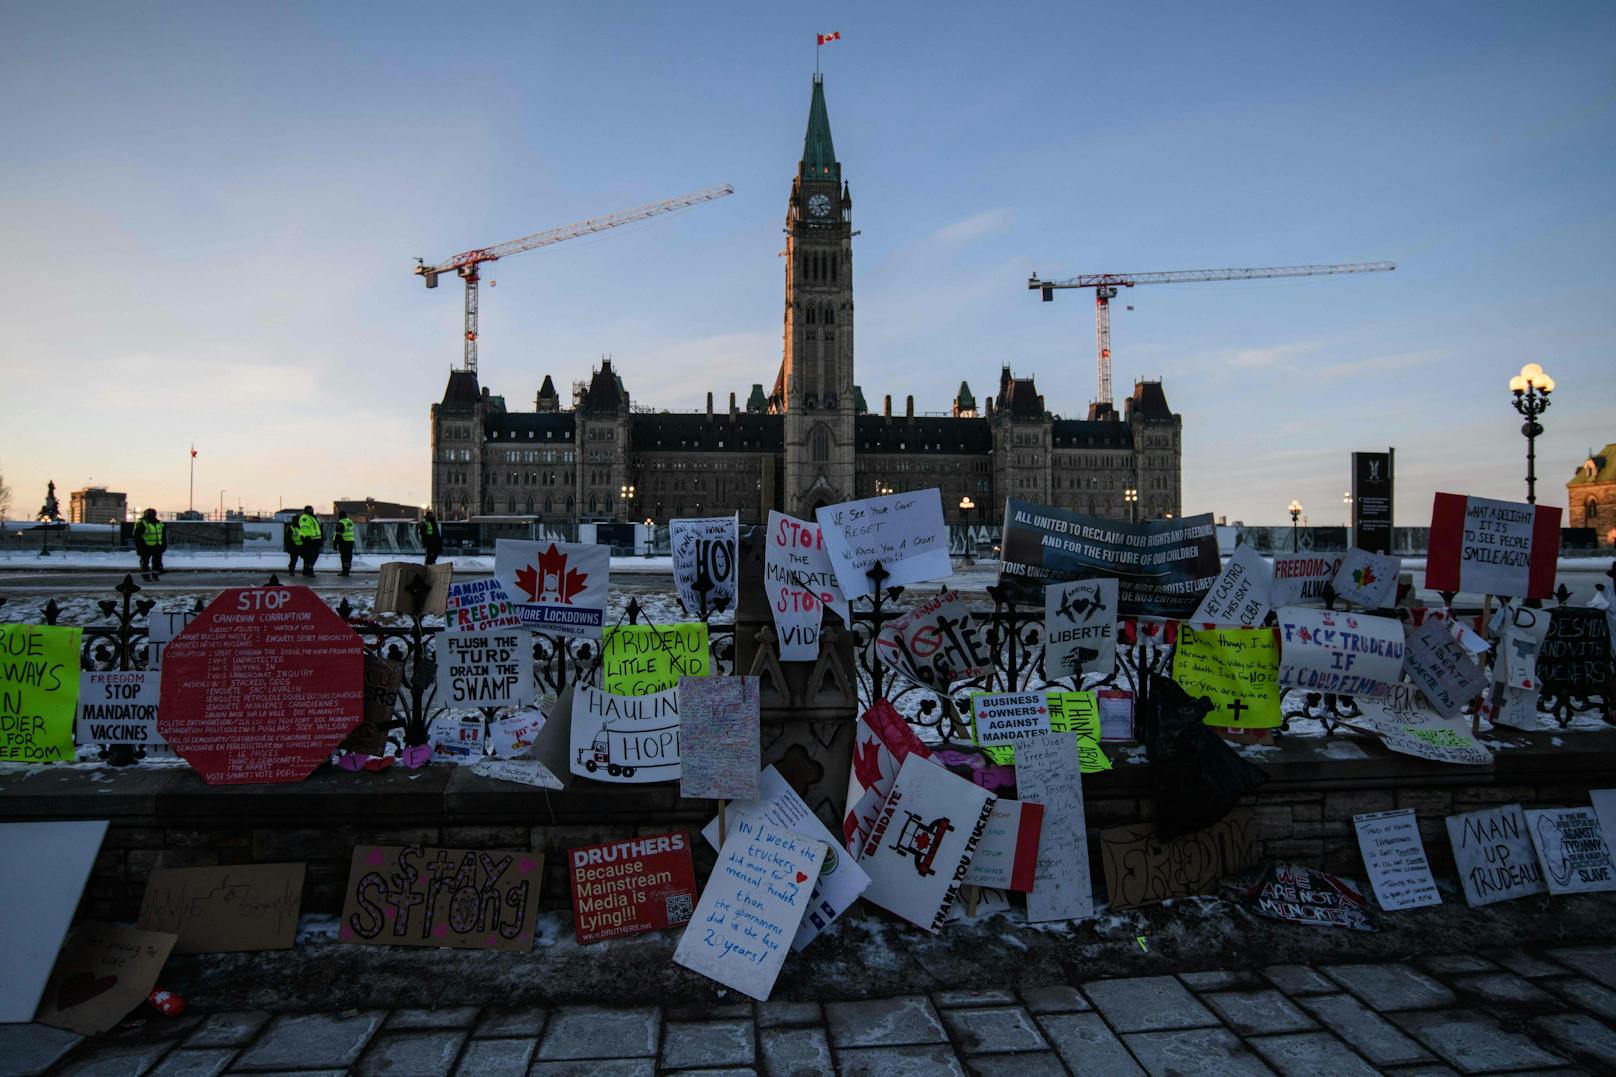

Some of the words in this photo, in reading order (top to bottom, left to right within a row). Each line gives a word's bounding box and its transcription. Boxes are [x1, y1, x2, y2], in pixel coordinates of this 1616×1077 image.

[831, 512, 843, 526] WE
[1466, 505, 1489, 519] WHAT
[1489, 508, 1497, 519] A
[1497, 508, 1533, 524] DELIGHT
[845, 522, 886, 538] RESET
[1015, 511, 1033, 525] ALL
[1033, 515, 1068, 533] UNITED
[1069, 522, 1081, 536] TO
[1082, 526, 1124, 546] RECLAIM
[1126, 535, 1147, 548] OUR
[1147, 532, 1170, 548] RIGHTS
[1170, 530, 1183, 542] AND
[1184, 524, 1213, 540] FREEDOMS
[1479, 520, 1492, 531] IT
[1495, 522, 1508, 533] IS
[881, 543, 895, 552] YOU
[1465, 530, 1477, 544] TO
[1478, 532, 1496, 545] SEE
[1500, 534, 1530, 550] PEOPLE
[789, 554, 809, 565] THE
[1041, 535, 1061, 548] AND
[1063, 540, 1081, 554] FOR
[1084, 545, 1101, 560] THE
[1102, 549, 1138, 565] FUTURE
[1140, 554, 1152, 566] OF
[1153, 552, 1167, 565] OUR
[1167, 545, 1199, 562] CHILDREN
[1463, 547, 1498, 565] SMILE
[1499, 550, 1530, 567] AGAIN
[767, 562, 839, 588] MANDATE
[1001, 561, 1026, 576] TOUS
[1027, 564, 1048, 578] UNIS
[1185, 580, 1194, 593] ET
[1204, 596, 1221, 618] HEY
[1216, 562, 1246, 600] CASTRO,
[237, 591, 291, 611] STOP
[778, 588, 834, 613] STOP
[1222, 600, 1239, 621] THIS
[1235, 578, 1252, 601] ISN'T
[213, 613, 255, 623] CANADIAN
[259, 612, 311, 622] CORRUPTION
[519, 607, 543, 621] MORE
[544, 608, 600, 625] LOCKDOWNS
[1240, 599, 1263, 626] CUBA
[480, 616, 521, 630] OTTAWA
[448, 637, 489, 649] FLUSH
[494, 636, 518, 648] THE
[609, 630, 700, 655] TRUDEAU
[1050, 625, 1111, 645] LIBERTÉ
[1339, 631, 1403, 659] TRUDEAU
[450, 665, 489, 676] DRAIN
[495, 664, 519, 675] THE
[1331, 652, 1356, 671] IF
[1430, 664, 1445, 678] NE
[0, 661, 64, 691] WAYS
[91, 674, 145, 683] FREEDOM
[1250, 671, 1266, 683] NO
[106, 684, 141, 699] STOP
[452, 676, 519, 701] SWAMP
[608, 683, 625, 696] IS
[589, 690, 679, 720] HAULIN
[983, 696, 1039, 707] BUSINESS
[1047, 693, 1065, 719] THE
[988, 707, 1037, 718] OWNERS
[1066, 693, 1097, 741] THINK
[90, 725, 148, 740] VACCINES
[989, 718, 1039, 729] AGAINST
[7, 732, 36, 746] FOR
[983, 729, 1048, 741] MANDATES!
[1041, 737, 1064, 748] Does
[865, 790, 902, 857] MANDATE
[1463, 812, 1519, 848] MAN
[1564, 827, 1594, 839] AGAINST
[573, 832, 685, 868] DRUTHERS
[739, 822, 753, 834] IN
[754, 825, 764, 842] 1
[766, 833, 797, 852] week
[800, 846, 816, 862] the
[1563, 840, 1601, 854] TYRANNY
[748, 845, 796, 874] truckers
[1484, 844, 1510, 867] UP
[575, 861, 644, 883] Because
[729, 852, 744, 865] did
[746, 862, 767, 874] more
[771, 869, 784, 880] for
[787, 881, 800, 897] my
[1470, 862, 1538, 898] TRUDEAU
[1578, 867, 1611, 883] SLAVE
[577, 870, 672, 897] Mainstream
[726, 866, 762, 888] mental
[767, 882, 795, 906] health
[931, 884, 960, 932] THANK
[951, 853, 973, 884] YOU
[1261, 881, 1300, 903] ARE
[1300, 889, 1335, 905] NOT
[579, 894, 629, 914] Media
[631, 889, 646, 906] is
[736, 890, 764, 910] than
[580, 907, 637, 932] Lying!!!
[715, 899, 731, 912] the
[732, 909, 783, 936] government
[706, 911, 725, 925] did
[731, 922, 739, 931] in
[744, 926, 758, 940] the
[762, 933, 779, 950] last
[703, 928, 725, 947] 20
[716, 940, 768, 965] years!
